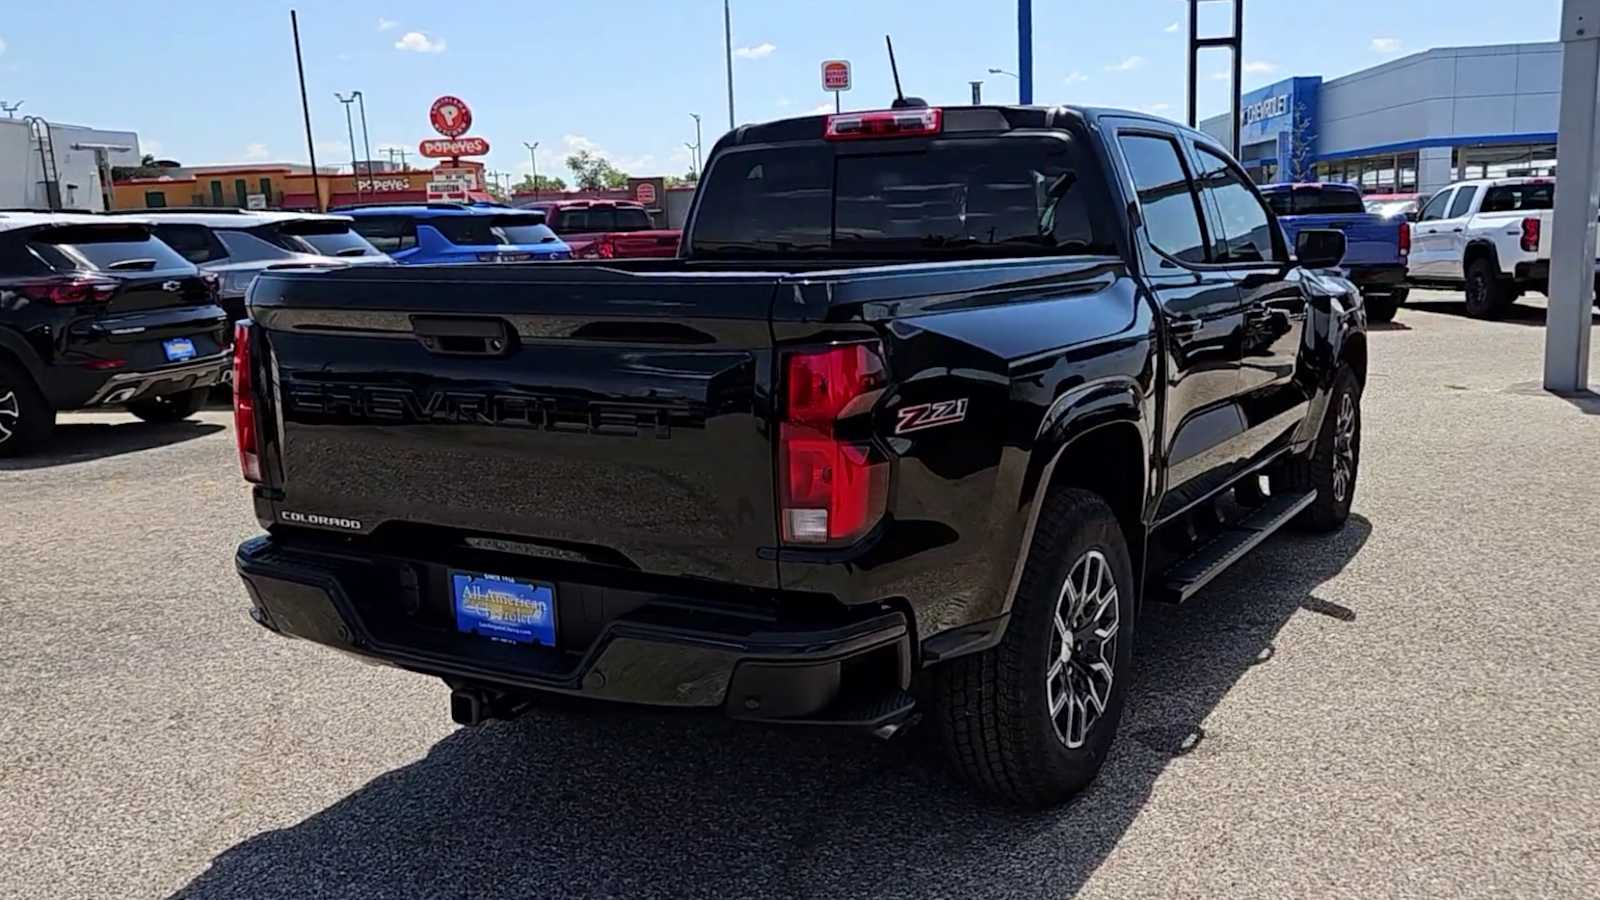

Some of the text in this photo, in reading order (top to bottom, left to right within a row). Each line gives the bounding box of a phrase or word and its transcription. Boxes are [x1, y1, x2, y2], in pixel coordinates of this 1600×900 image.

[1247, 94, 1289, 124] CHEVROLET
[289, 380, 690, 440] CHEVROLET
[895, 398, 969, 434] Z71
[281, 511, 361, 529] COLORADO
